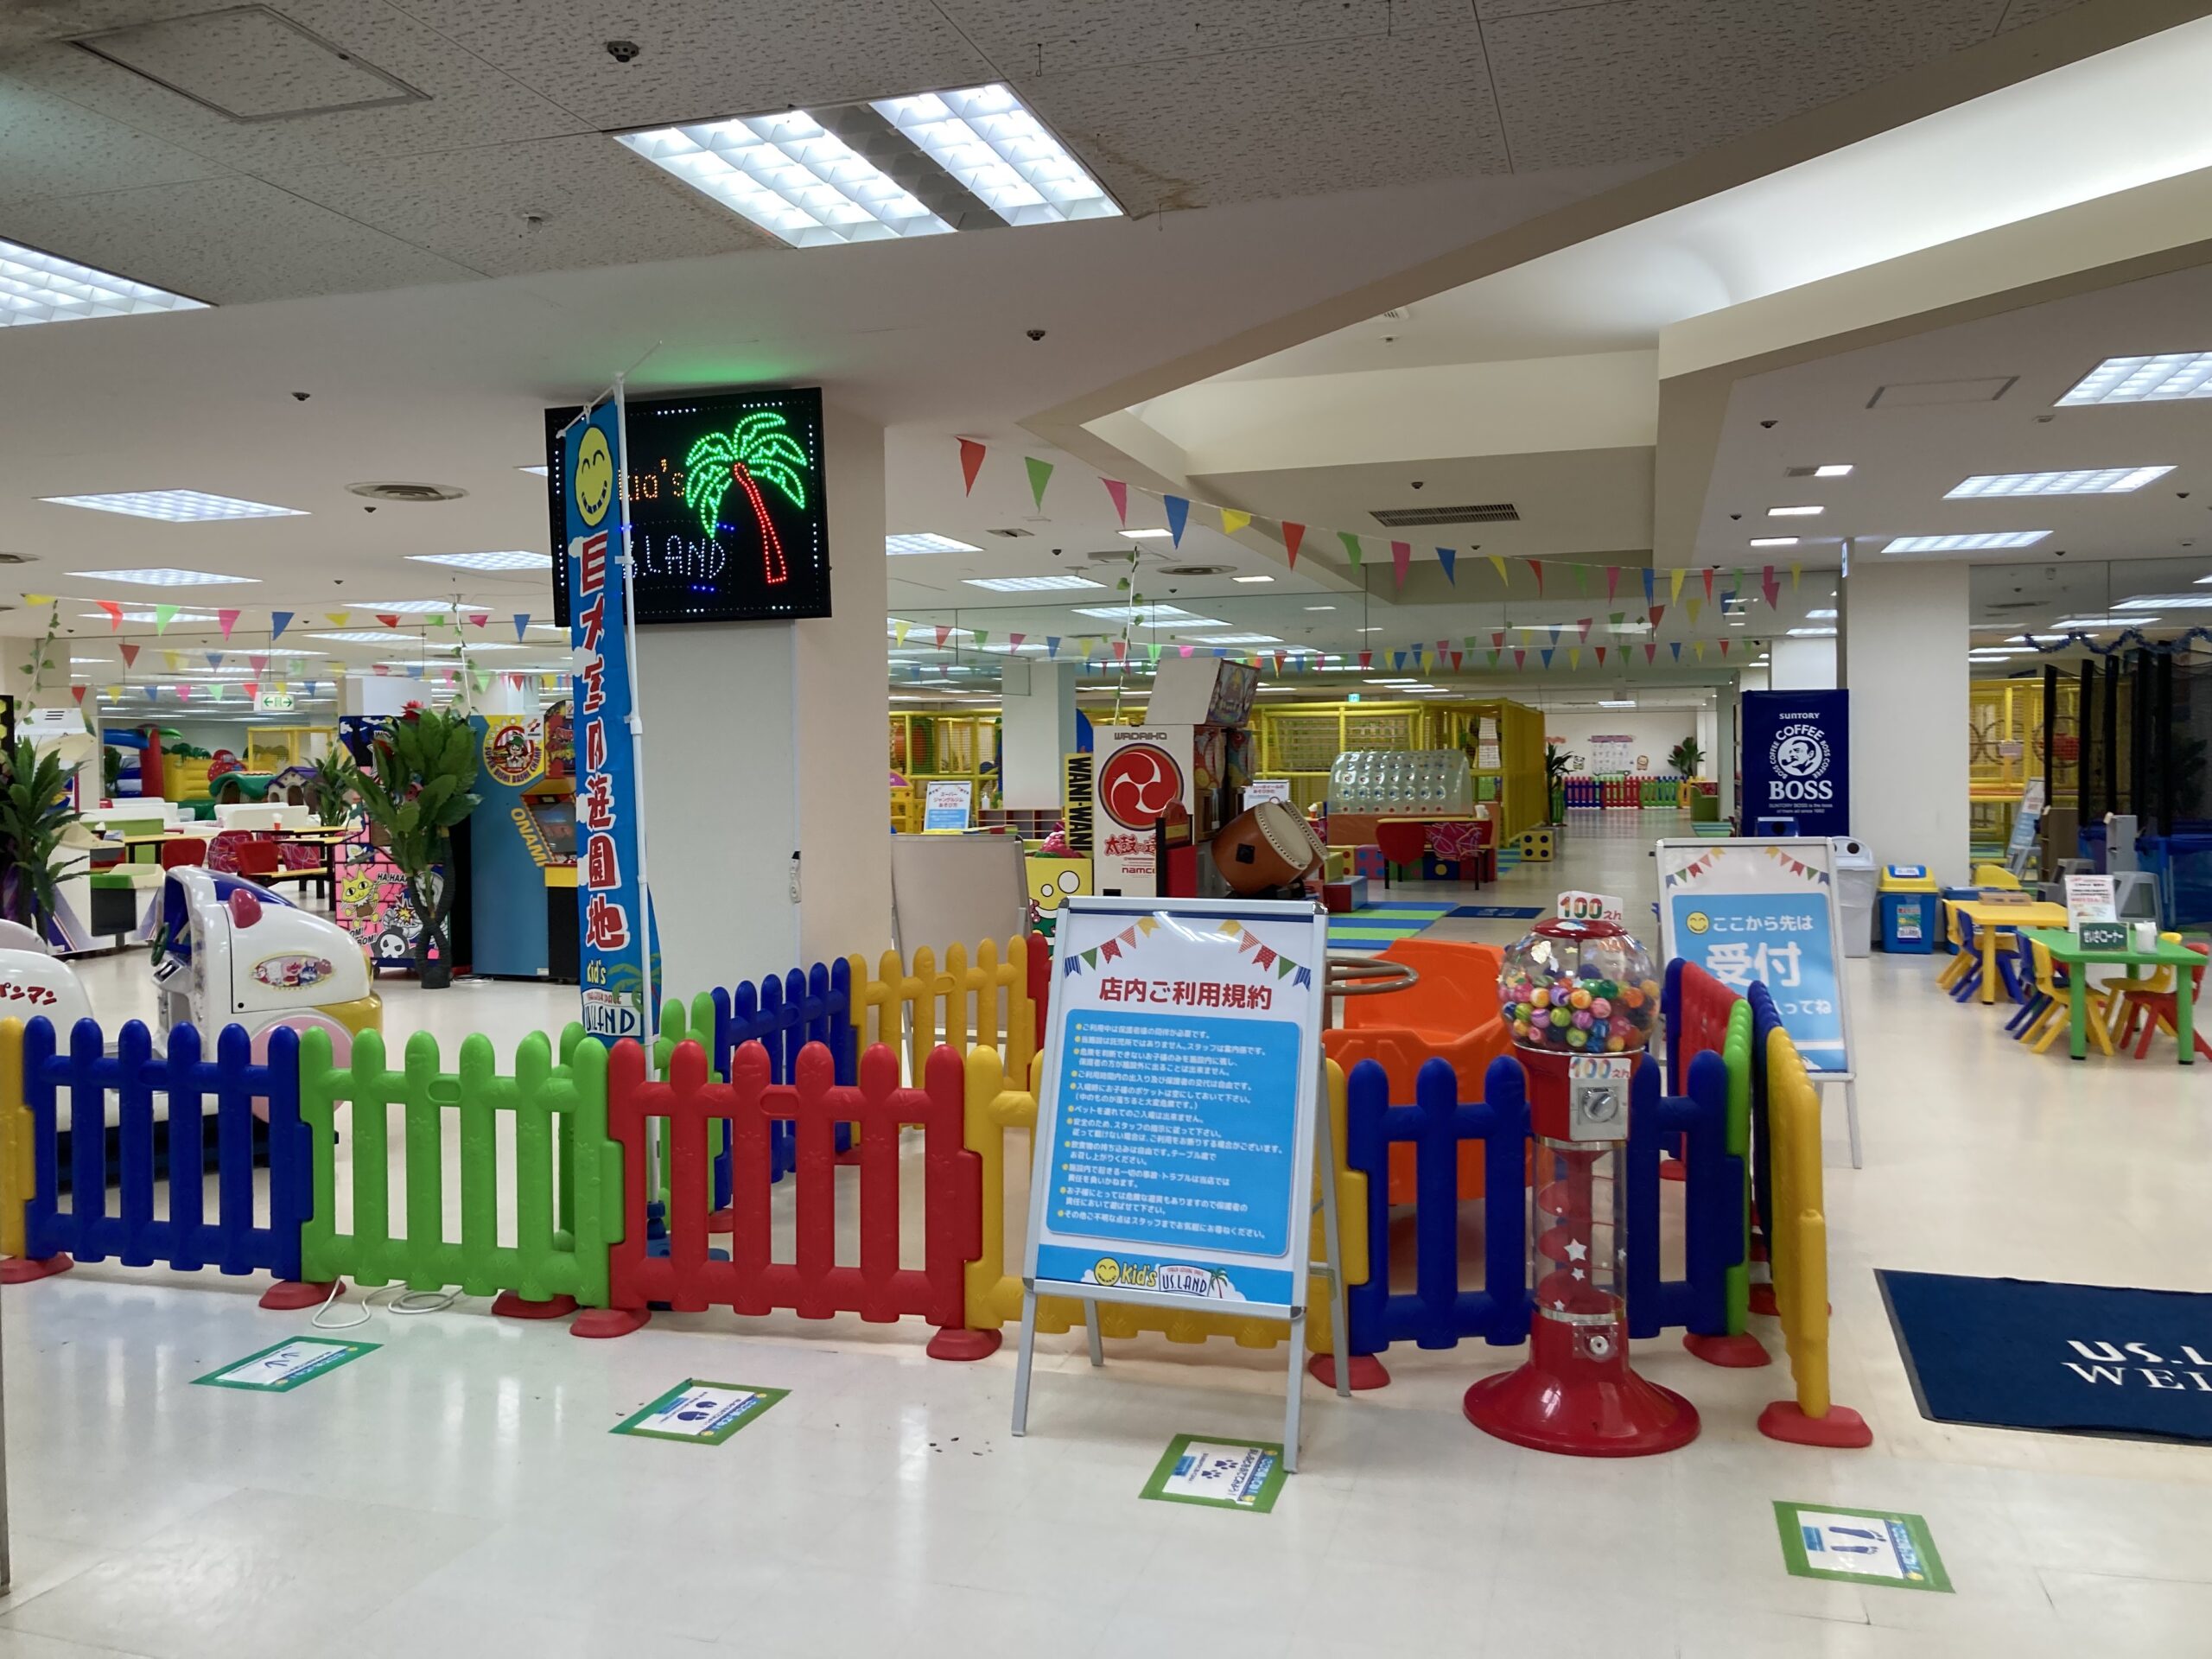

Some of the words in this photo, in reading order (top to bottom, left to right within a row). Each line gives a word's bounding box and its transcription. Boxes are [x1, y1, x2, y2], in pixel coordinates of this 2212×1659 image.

[1776, 724, 1824, 741] COFFEE
[1769, 780, 1833, 800] BOSS
[1713, 914, 1814, 932] ここから先は
[1706, 941, 1802, 988] 受付
[1099, 976, 1273, 1011] 店内ご利用規約
[1121, 1262, 1158, 1287] Kid's
[1161, 1274, 1207, 1294] US.LAND
